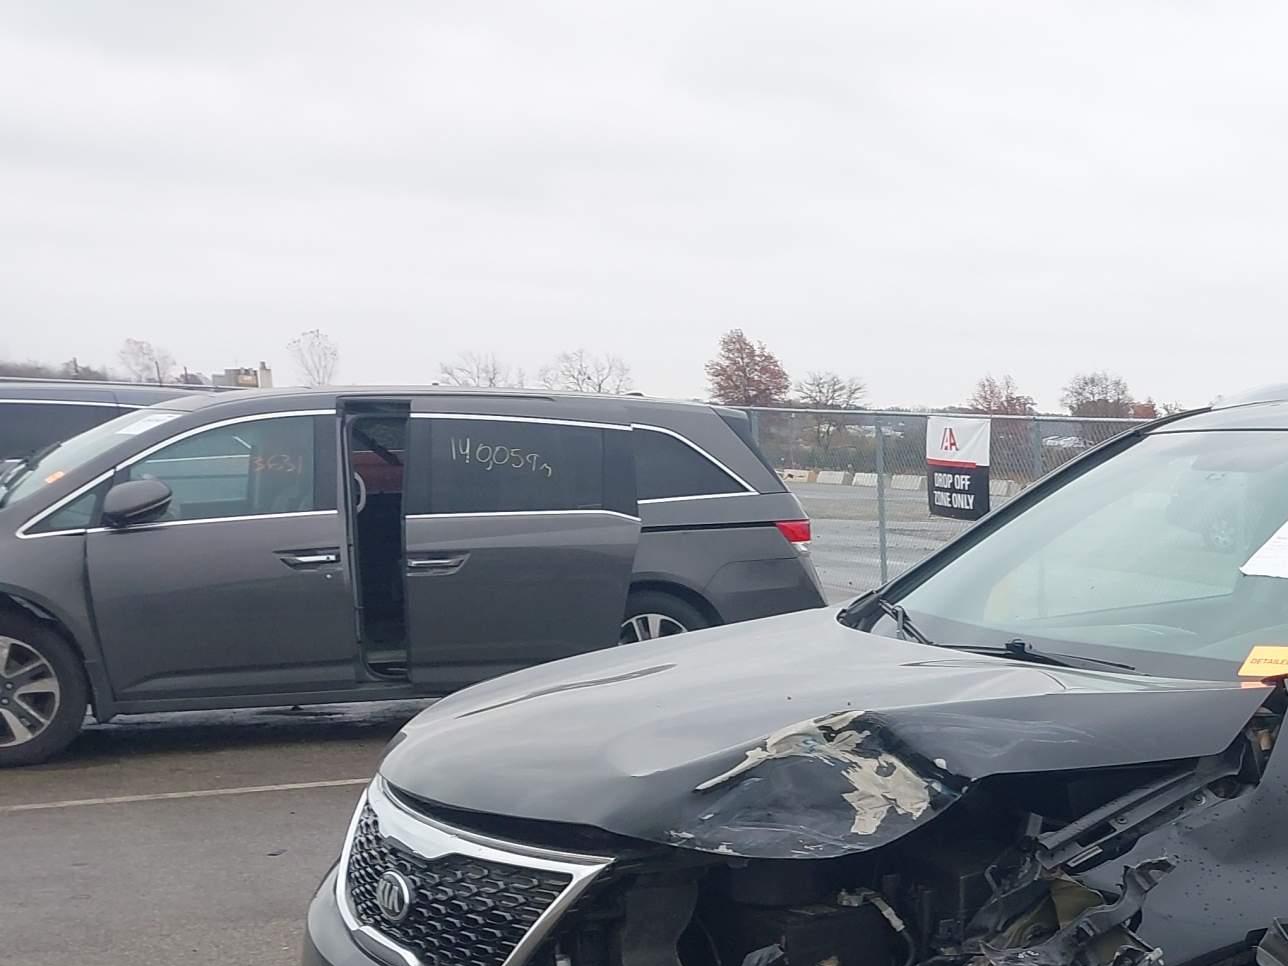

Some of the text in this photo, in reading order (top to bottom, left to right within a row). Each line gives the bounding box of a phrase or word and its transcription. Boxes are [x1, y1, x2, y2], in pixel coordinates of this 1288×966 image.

[934, 472, 971, 490] DROP OFF
[933, 490, 975, 510] ZONE ONLY
